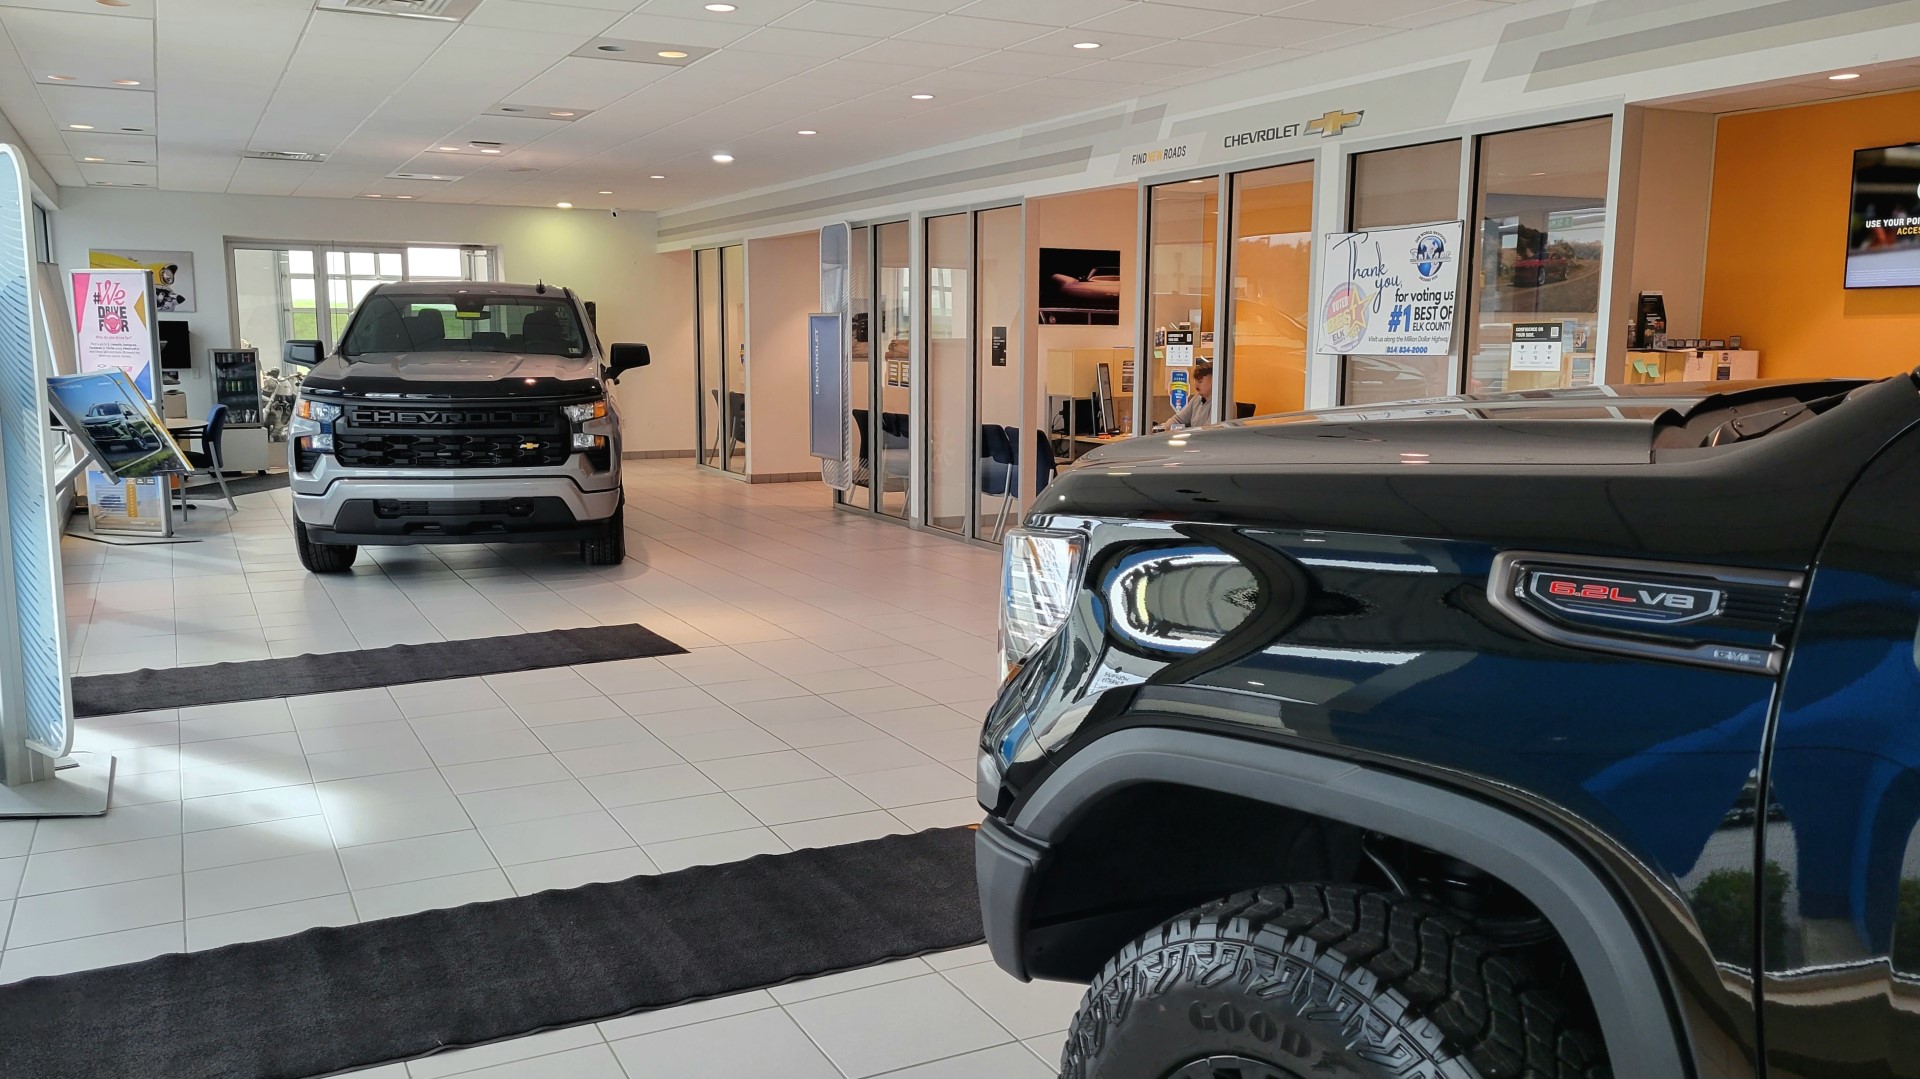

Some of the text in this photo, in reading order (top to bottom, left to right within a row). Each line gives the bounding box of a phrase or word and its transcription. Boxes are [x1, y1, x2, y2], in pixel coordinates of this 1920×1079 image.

[1224, 123, 1300, 148] CHEVROLET
[1131, 152, 1148, 166] FIND
[1163, 145, 1187, 160] ROADS
[1866, 219, 1881, 228] USE
[1883, 218, 1904, 227] YOUR
[1332, 231, 1389, 297] Thank
[1332, 296, 1349, 312] VOTED
[1395, 287, 1454, 306] for voting us
[97, 305, 128, 320] DRIVE
[1387, 304, 1454, 333] #1 BEST OF
[1332, 330, 1345, 342] ELK
[1412, 321, 1452, 332] ELK COUNTY
[352, 410, 551, 424] CHEVROLET
[1549, 581, 1695, 609] 6.2L V8
[1188, 1000, 1311, 1058] GOOD
